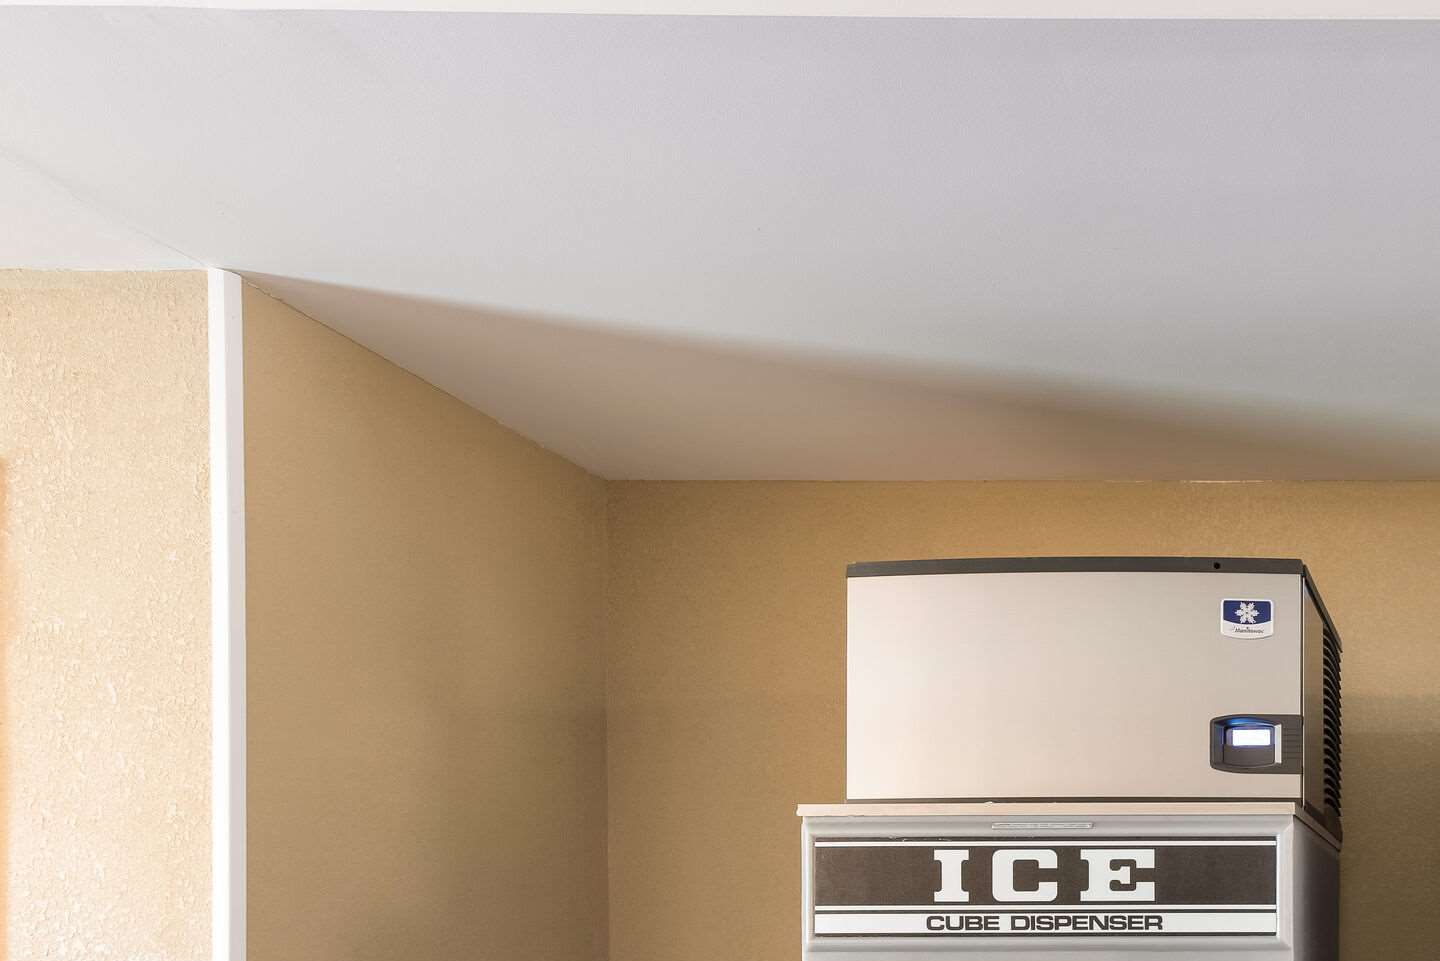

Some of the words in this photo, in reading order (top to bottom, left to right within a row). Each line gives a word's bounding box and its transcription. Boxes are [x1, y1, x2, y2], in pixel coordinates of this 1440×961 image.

[933, 848, 1156, 902] ICE
[926, 915, 1000, 931] CUBE
[1011, 914, 1163, 931] DISPENSER
